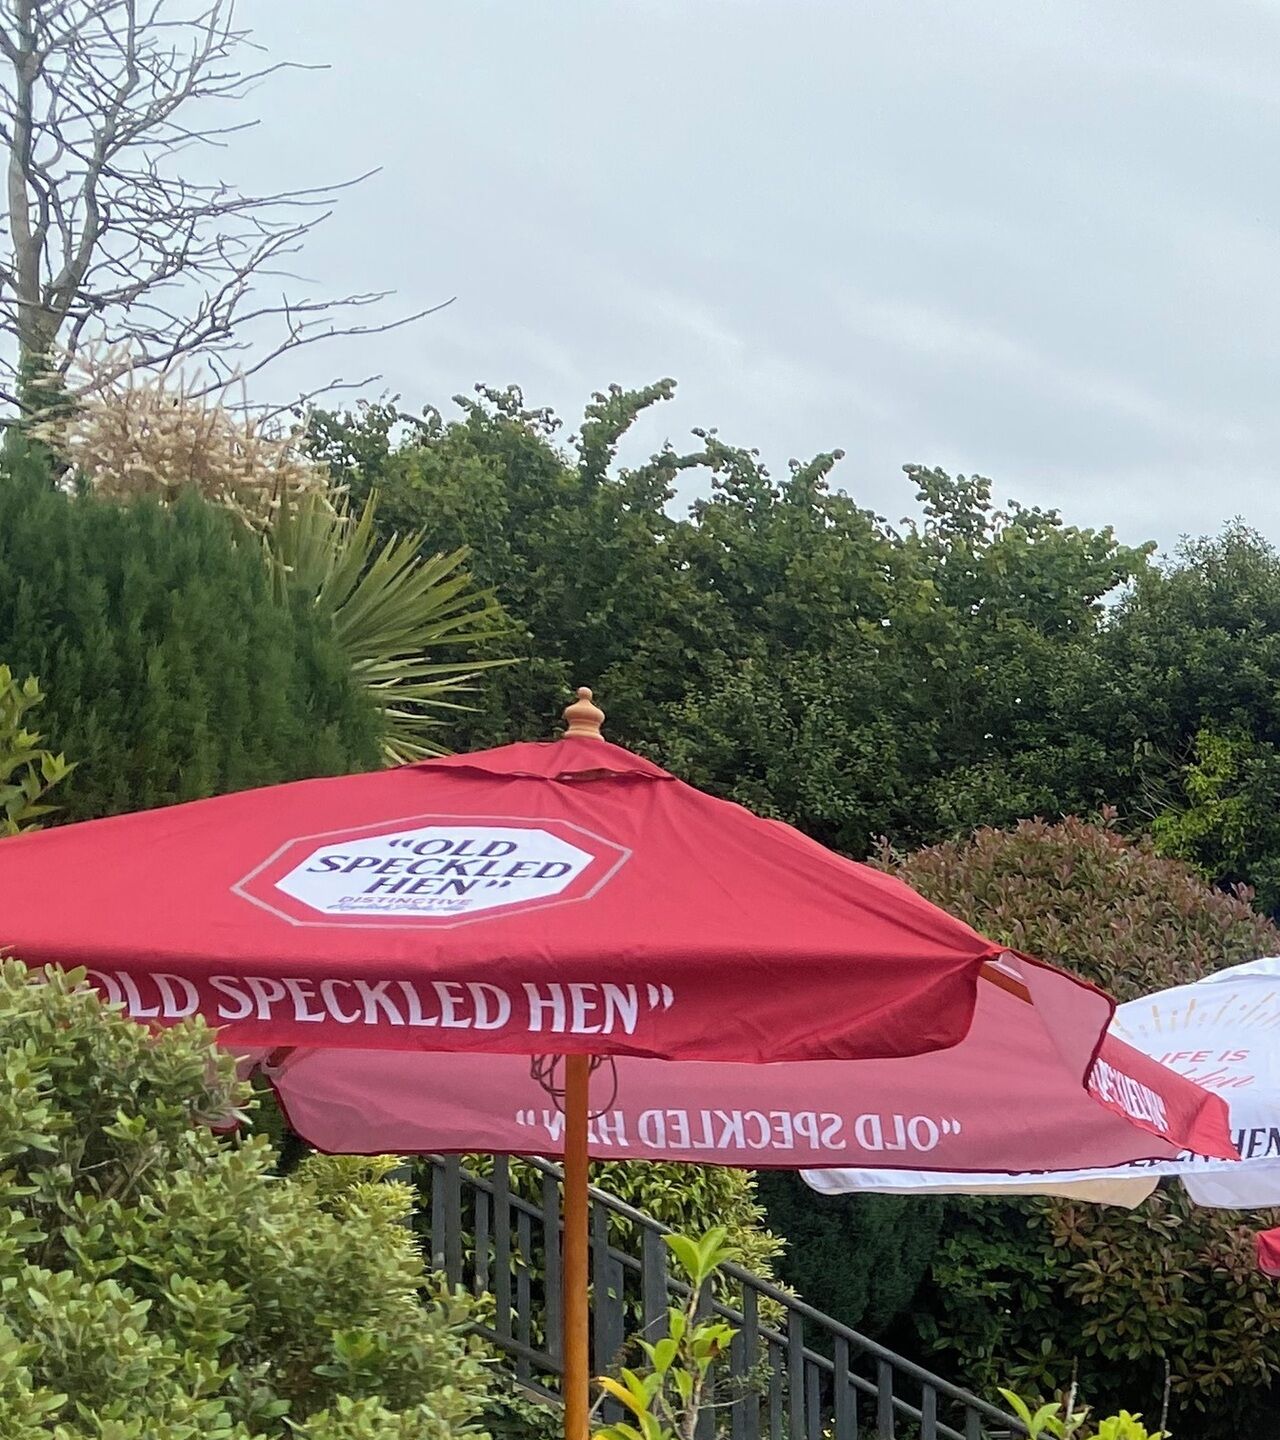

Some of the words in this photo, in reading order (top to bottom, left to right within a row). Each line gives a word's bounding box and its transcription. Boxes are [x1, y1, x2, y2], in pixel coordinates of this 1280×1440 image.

[389, 839, 518, 858] “OLD
[306, 855, 572, 879] SPECKLED
[363, 877, 511, 896] HEN”
[209, 975, 511, 1030] SPECKLED
[522, 983, 674, 1035] HEN”
[1148, 1050, 1213, 1064] IFE
[1217, 1049, 1250, 1062] IS
